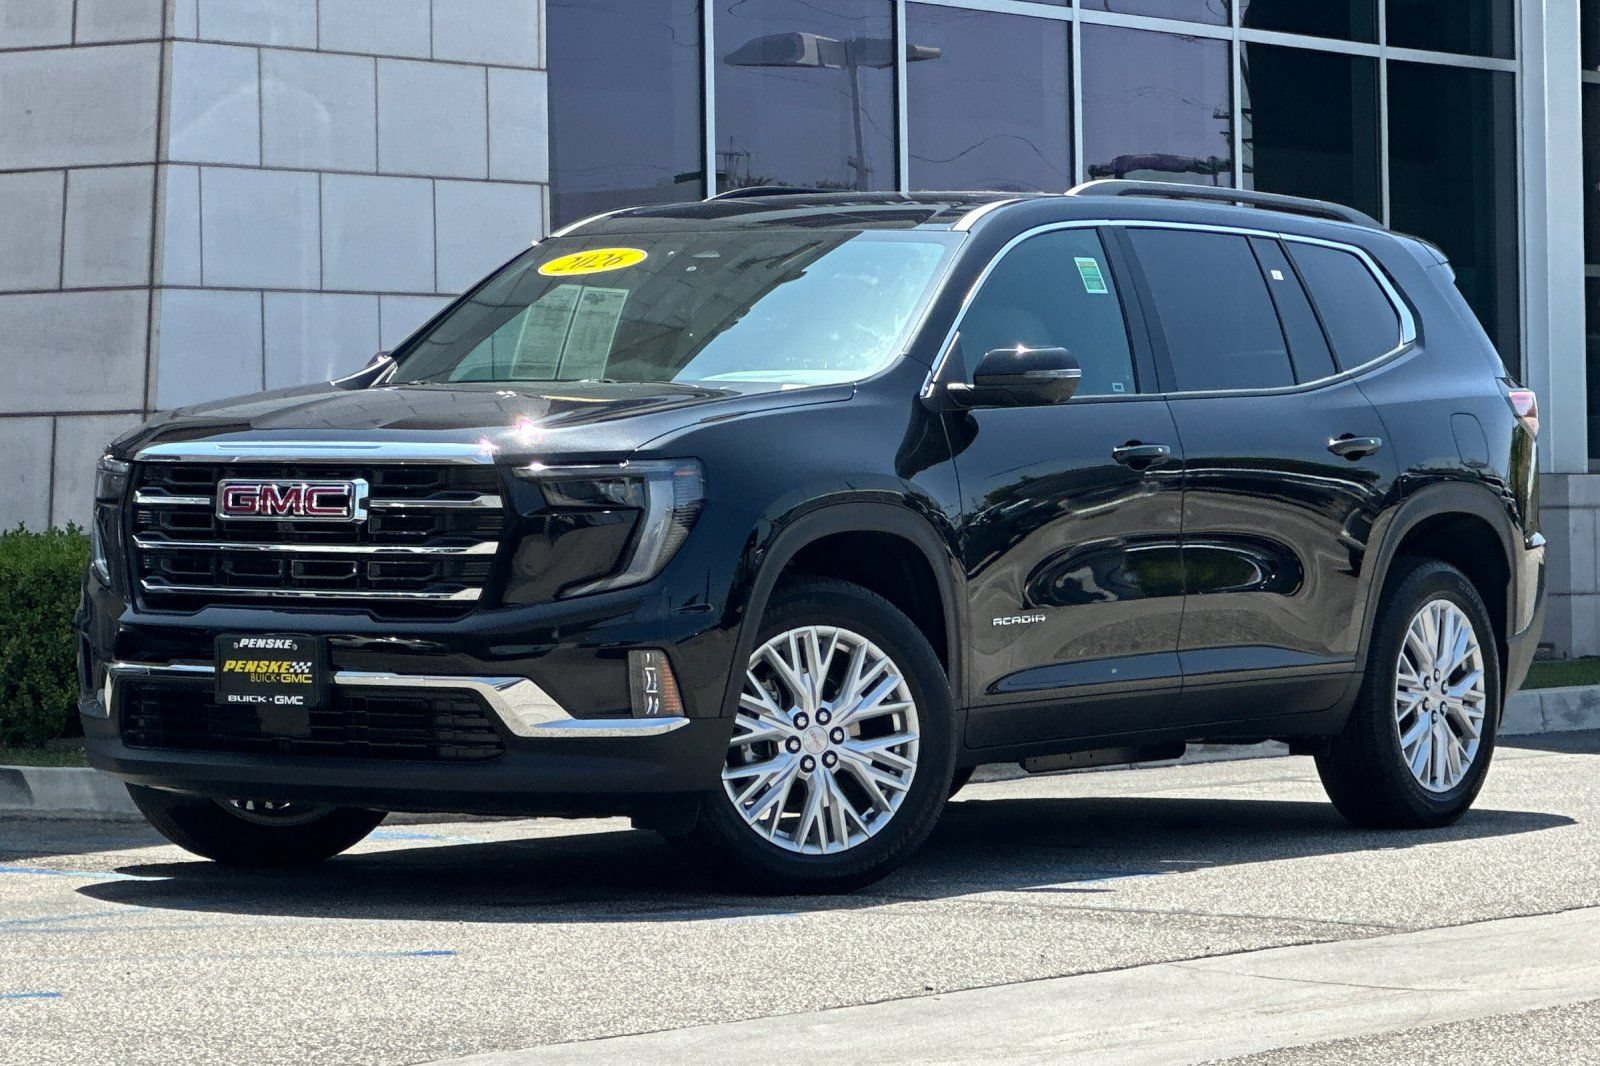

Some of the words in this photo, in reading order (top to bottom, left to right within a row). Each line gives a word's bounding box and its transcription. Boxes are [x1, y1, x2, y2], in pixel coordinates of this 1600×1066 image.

[552, 252, 629, 272] 2026
[222, 484, 350, 517] GMC
[992, 614, 1046, 626] ACADIA
[239, 638, 293, 649] PENSKE
[222, 660, 291, 673] PENSKE
[227, 695, 267, 703] BUICK
[274, 696, 304, 705] GMC
